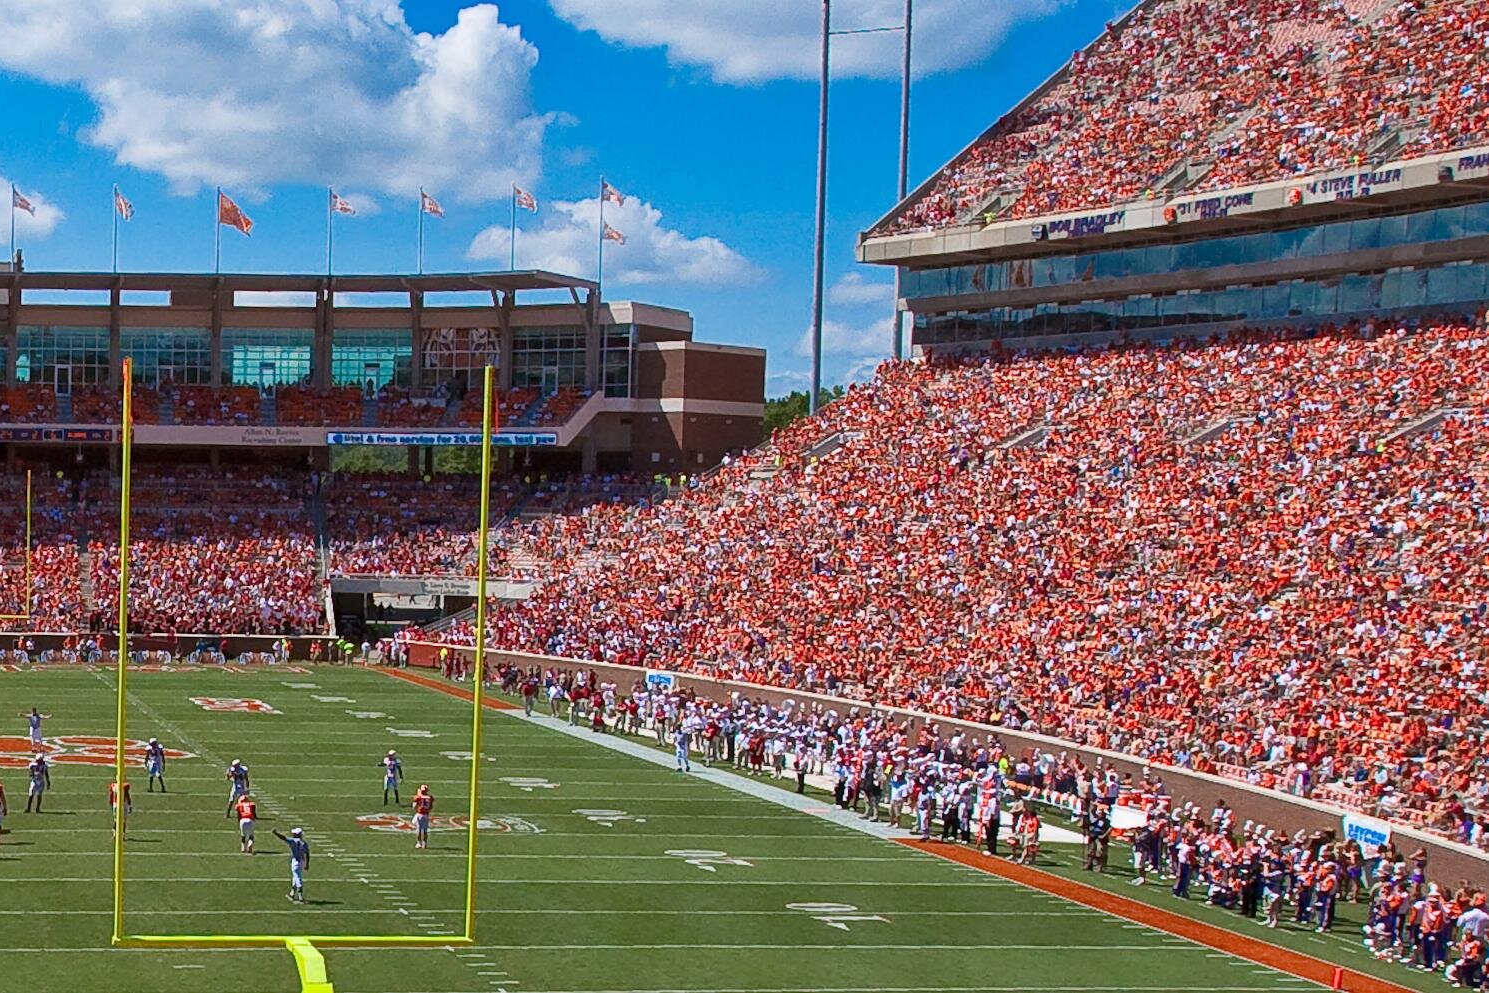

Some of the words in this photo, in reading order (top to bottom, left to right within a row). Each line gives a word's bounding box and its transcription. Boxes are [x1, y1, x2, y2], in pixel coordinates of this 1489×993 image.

[1320, 176, 1355, 194] STEVE
[1358, 169, 1402, 187] FULLER
[1195, 197, 1220, 213] FRED
[1224, 192, 1254, 209] CONE
[1048, 219, 1071, 234] BOB
[1073, 210, 1126, 231] BRADLEY
[785, 902, 895, 924] 10
